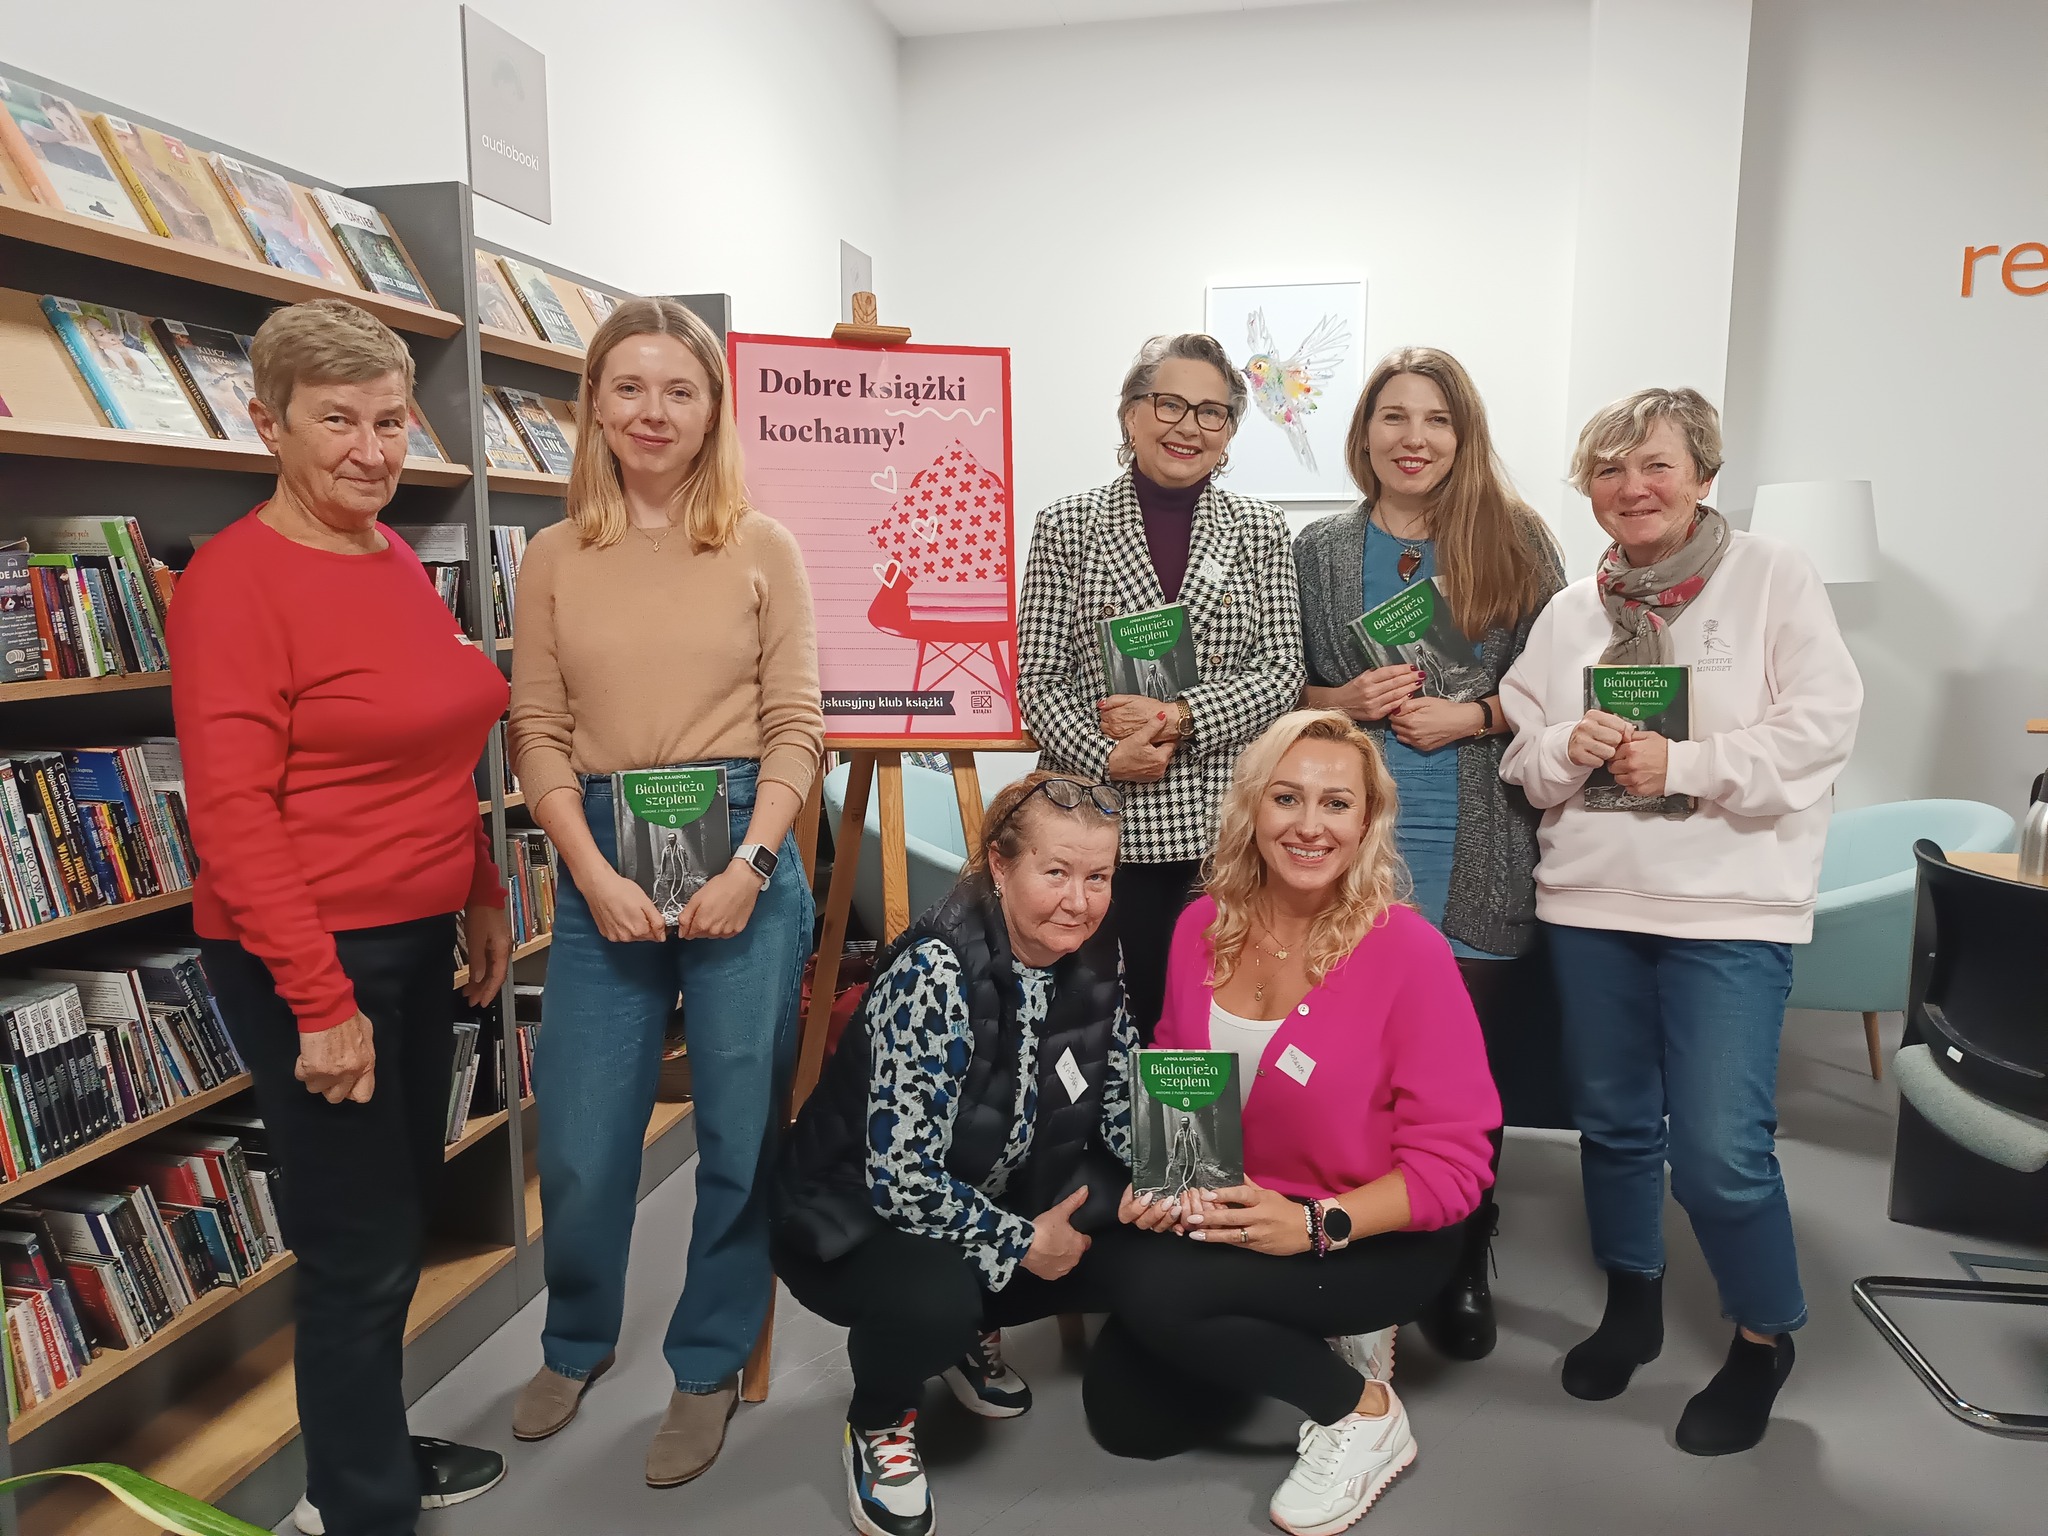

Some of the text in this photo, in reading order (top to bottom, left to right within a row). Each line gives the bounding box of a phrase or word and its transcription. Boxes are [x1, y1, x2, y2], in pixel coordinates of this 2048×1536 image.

[481, 133, 539, 171] audiobooki
[344, 210, 377, 230] CARTER
[514, 287, 527, 304] LINK
[540, 308, 570, 330] LINK
[195, 354, 237, 367] JEFFERSONA
[197, 346, 228, 358] KLUCZ
[172, 355, 212, 419] KLUCZ JEFFERSONA
[759, 368, 966, 407] Dobre książki
[513, 418, 526, 436] LINK
[537, 437, 566, 454] LINK
[759, 415, 905, 452] kochamy!
[820, 696, 944, 710] yskusyjny klub książki
[38, 774, 50, 801] WOJCIECH
[45, 767, 73, 835] Wojciech Chmielarz
[58, 773, 80, 824] GAMBIT
[22, 846, 47, 903] KRÓLOWA
[56, 842, 77, 883] WAMPIR
[73, 856, 93, 896] PRZEJĘCIE
[29, 1009, 47, 1049] Lisa Gardner
[40, 1005, 58, 1045] Lisa Gardner
[55, 1007, 68, 1037] Lisa Gardner
[70, 993, 87, 1032] Lisa Gardner
[7, 1017, 22, 1051] Lisa Gardner
[18, 1012, 35, 1052] Lisa Gardner
[35, 1299, 47, 1321] DOM
